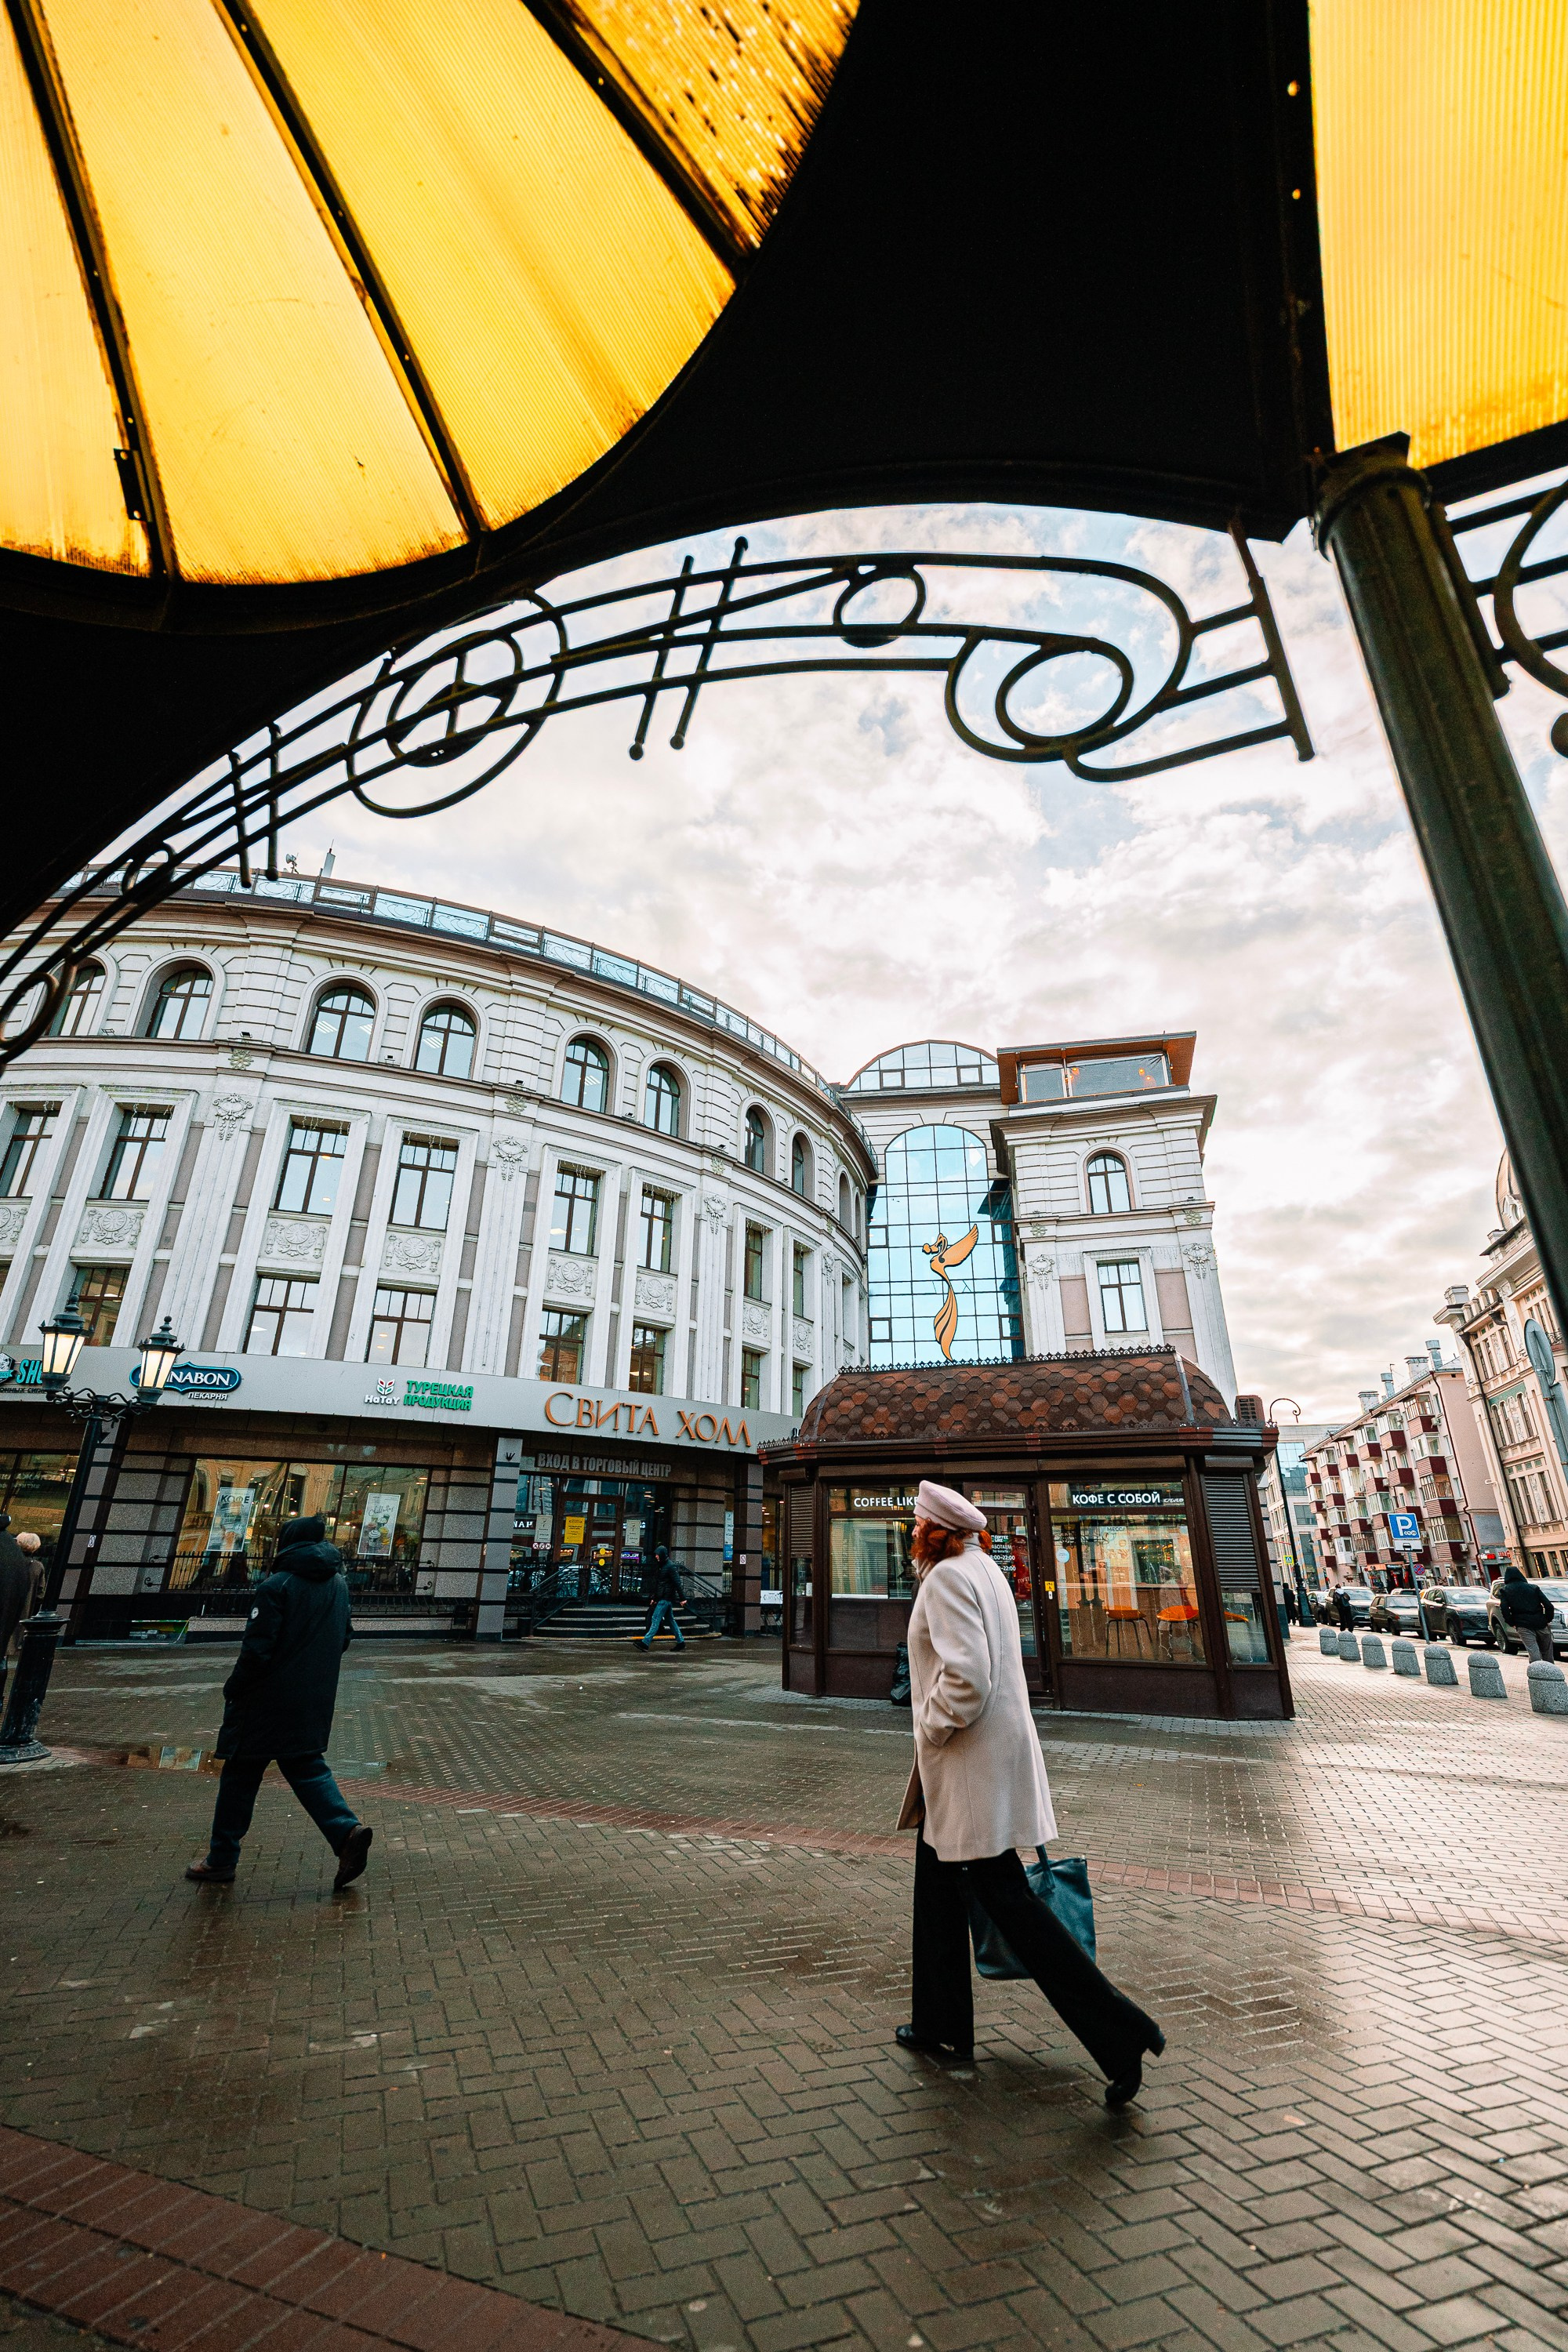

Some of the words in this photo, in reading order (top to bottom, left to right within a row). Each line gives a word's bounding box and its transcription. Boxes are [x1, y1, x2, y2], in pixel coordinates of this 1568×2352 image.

[188, 1392, 228, 1401] ПЕКАРНЯ
[407, 1380, 474, 1398] ТУРЕЦКАЯ
[403, 1394, 471, 1411] ПРОДУКЦИЯ
[545, 1392, 659, 1436] СВИТА
[676, 1410, 752, 1447] ХОЛЛ
[538, 1453, 569, 1470] ВХОД
[572, 1455, 580, 1467] В
[583, 1457, 641, 1475] ТОРГОВЫЙ
[641, 1461, 672, 1478] ЦЕНТР
[220, 1494, 250, 1504] КОФЕ
[854, 1497, 894, 1507] COFFEE
[1073, 1494, 1105, 1504] КОФЕ
[1107, 1494, 1116, 1504] С
[1118, 1491, 1160, 1504] СОБОЙ
[1396, 1516, 1412, 1537] P
